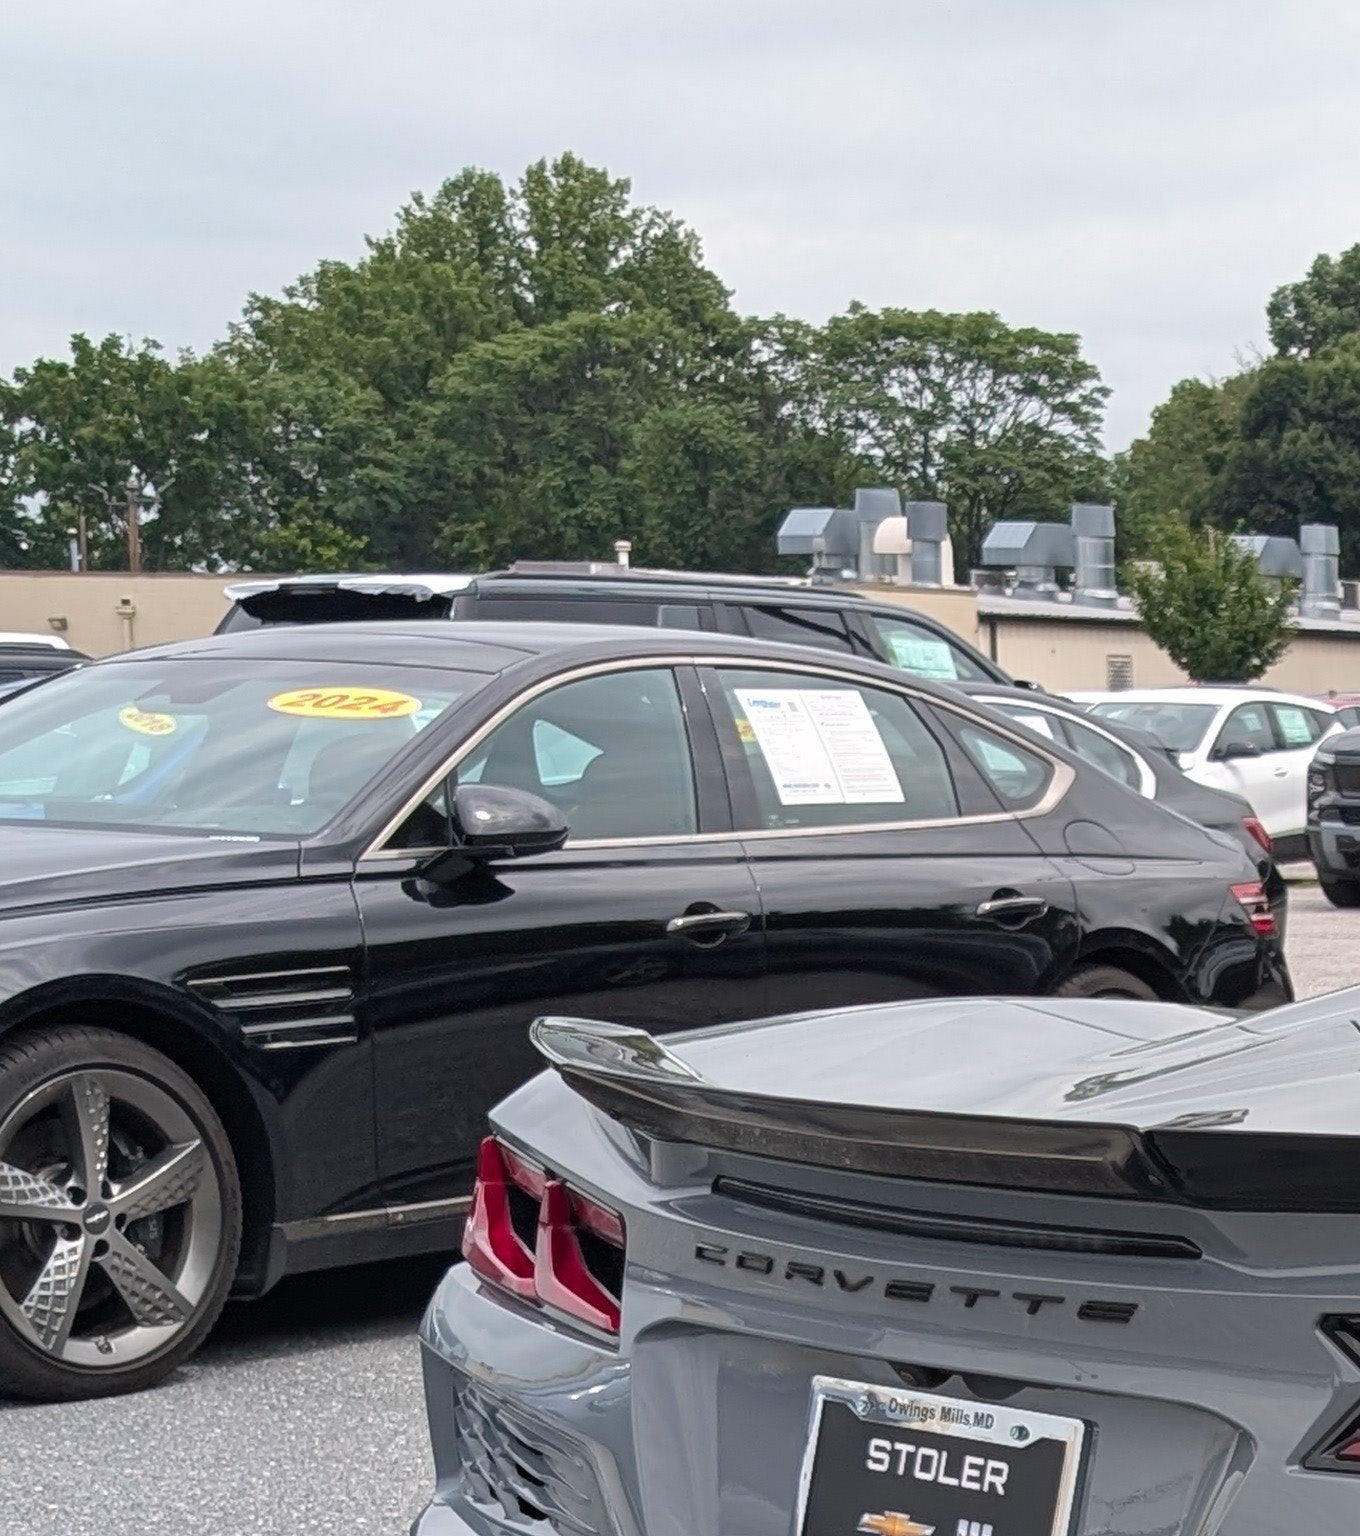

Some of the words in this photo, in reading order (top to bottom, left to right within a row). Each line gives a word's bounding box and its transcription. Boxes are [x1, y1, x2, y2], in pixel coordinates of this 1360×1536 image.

[280, 693, 409, 714] 2024
[694, 1241, 1139, 1324] CORVETTE
[888, 1397, 936, 1423] Owings
[866, 1437, 1010, 1496] STOLER
